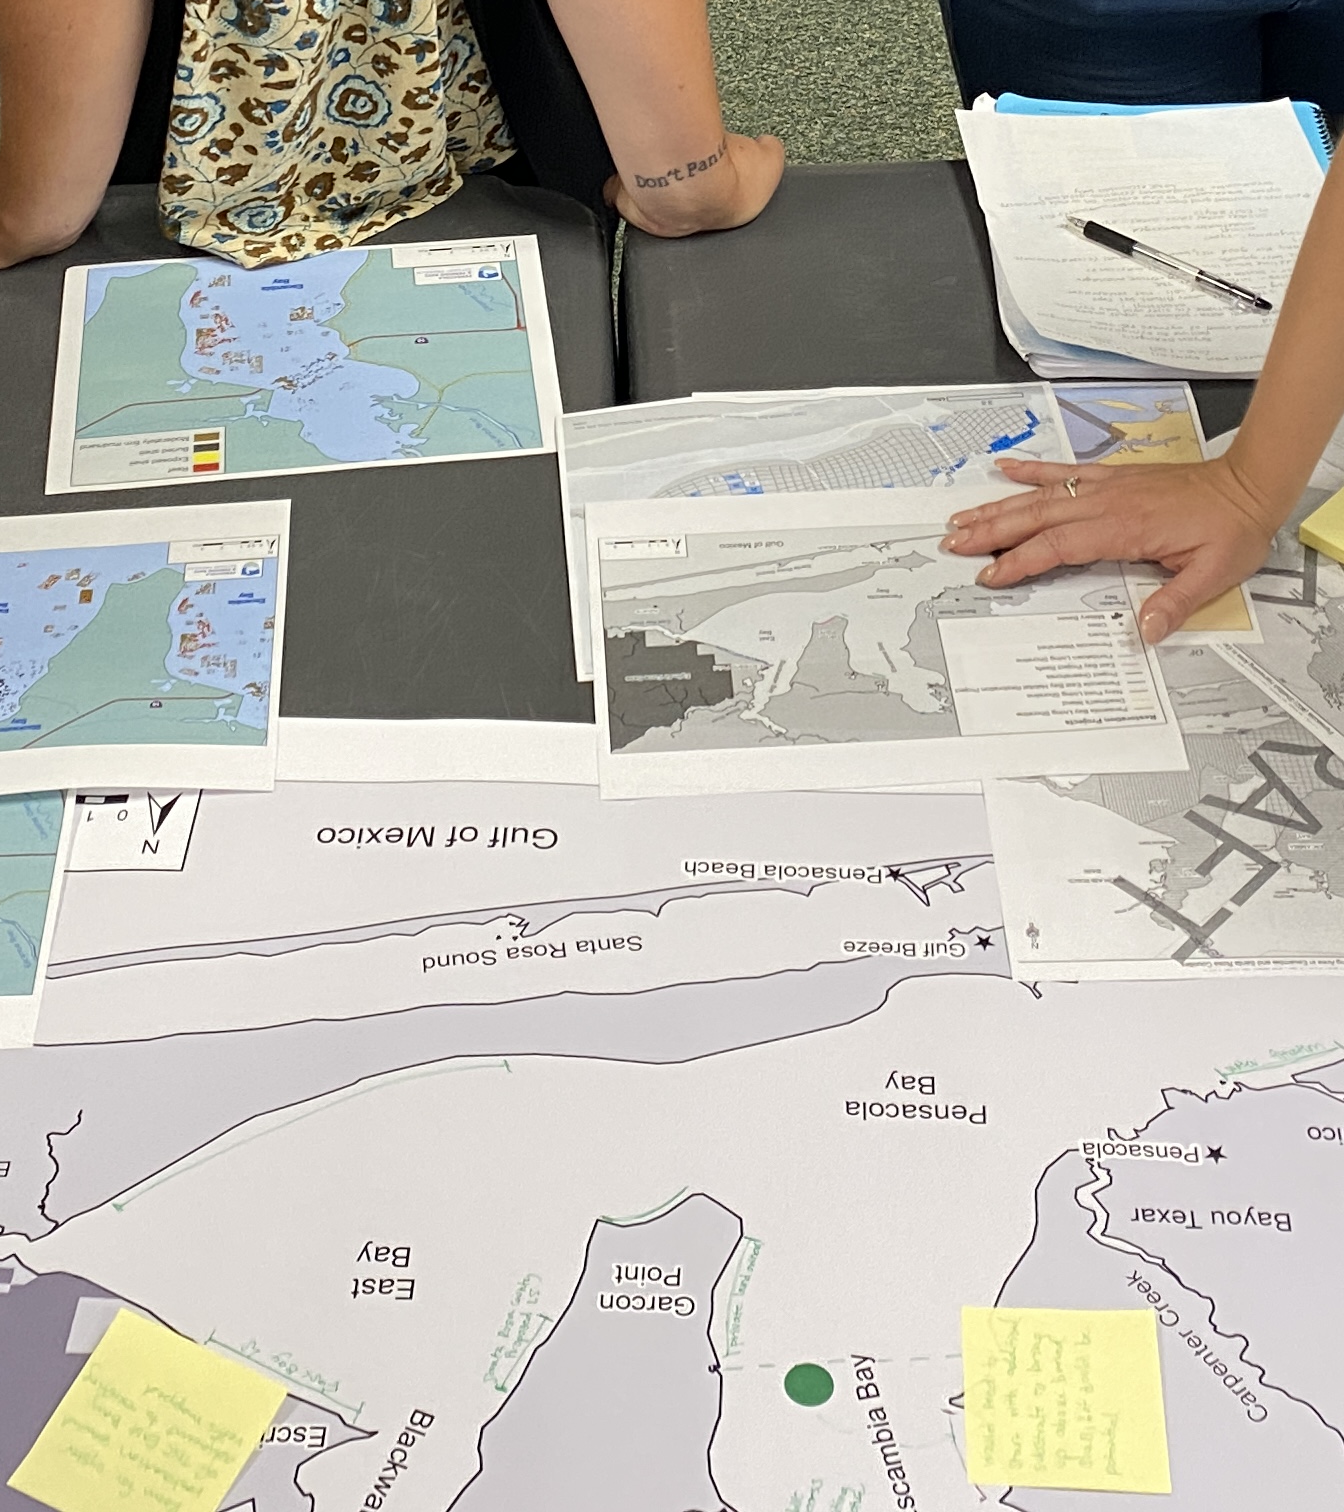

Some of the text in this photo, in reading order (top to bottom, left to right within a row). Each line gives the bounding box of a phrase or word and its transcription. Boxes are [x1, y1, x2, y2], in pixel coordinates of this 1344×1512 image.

[635, 168, 684, 188] Don't
[718, 540, 751, 551] Mexico
[760, 539, 785, 550] Gulf
[87, 810, 128, 821] 0 1
[142, 840, 159, 854] N
[317, 827, 557, 849] Gulf of Mexico
[685, 862, 884, 886] Pensacola Beach
[423, 936, 642, 973] Santa Rosa Sound
[844, 938, 965, 959] Gulf Breeze
[886, 1071, 935, 1095] Bay
[846, 1101, 986, 1124] Pensacola
[1083, 1137, 1198, 1165] Pensacola
[1132, 1207, 1291, 1231] Bayou Texar
[357, 1241, 410, 1267] Bay
[616, 1265, 680, 1286] Point
[352, 1279, 414, 1300] East
[601, 1295, 694, 1316] Garcon
[1125, 1270, 1269, 1423] Carpenter Creek
[852, 1356, 915, 1512] scambia Bay
